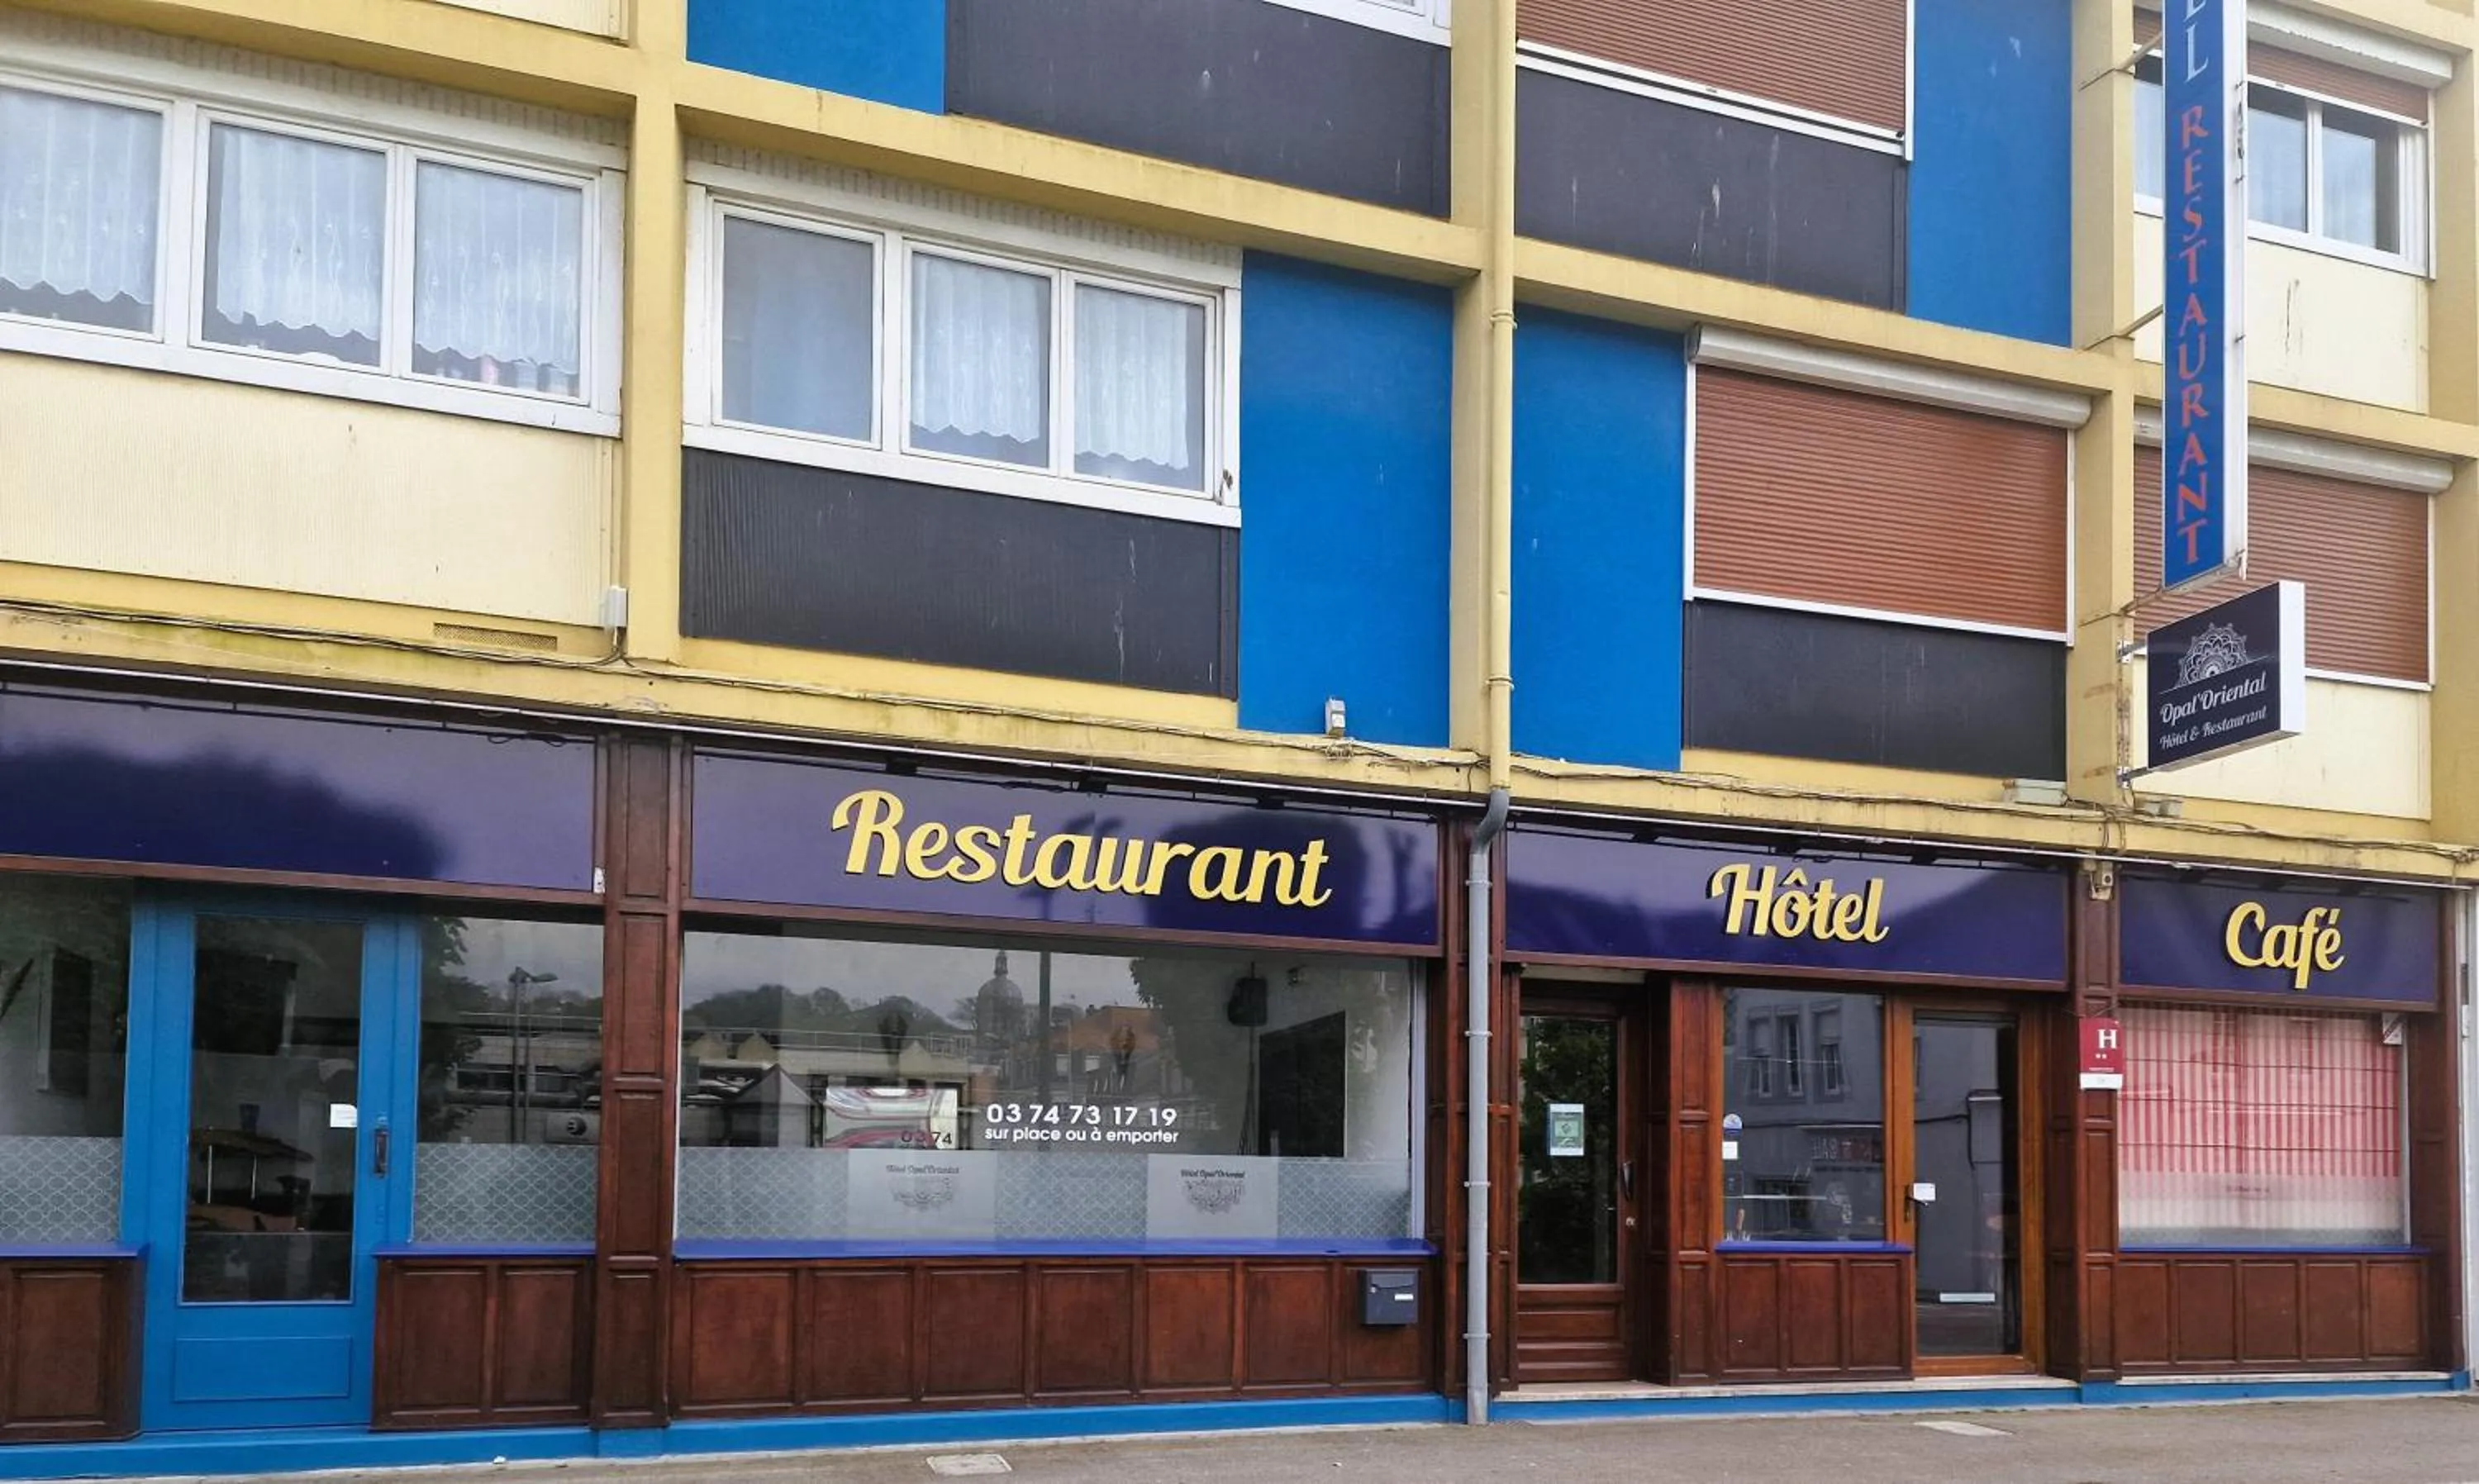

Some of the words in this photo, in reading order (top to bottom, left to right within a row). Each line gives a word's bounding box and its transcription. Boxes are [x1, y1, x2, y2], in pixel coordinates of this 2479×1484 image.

[2178, 105, 2209, 564] RESTAURANT
[2159, 727, 2189, 750] Hôtel
[2190, 727, 2200, 742] &
[2201, 705, 2267, 738] Restaurant
[830, 789, 1333, 907] Restaurant
[1710, 863, 1891, 944] Hôtel
[2225, 901, 2345, 989] Café
[2097, 1029, 2118, 1049] H
[984, 1127, 1009, 1140] sur
[1012, 1126, 1062, 1143] place
[1065, 1130, 1087, 1141] ou
[1090, 1126, 1102, 1142] à
[1106, 1130, 1179, 1145] emporter
[986, 1103, 1022, 1124] 03
[1029, 1105, 1060, 1125] 74
[1068, 1105, 1102, 1125] 73
[1113, 1106, 1139, 1126] 17
[1149, 1107, 1178, 1126] 19
